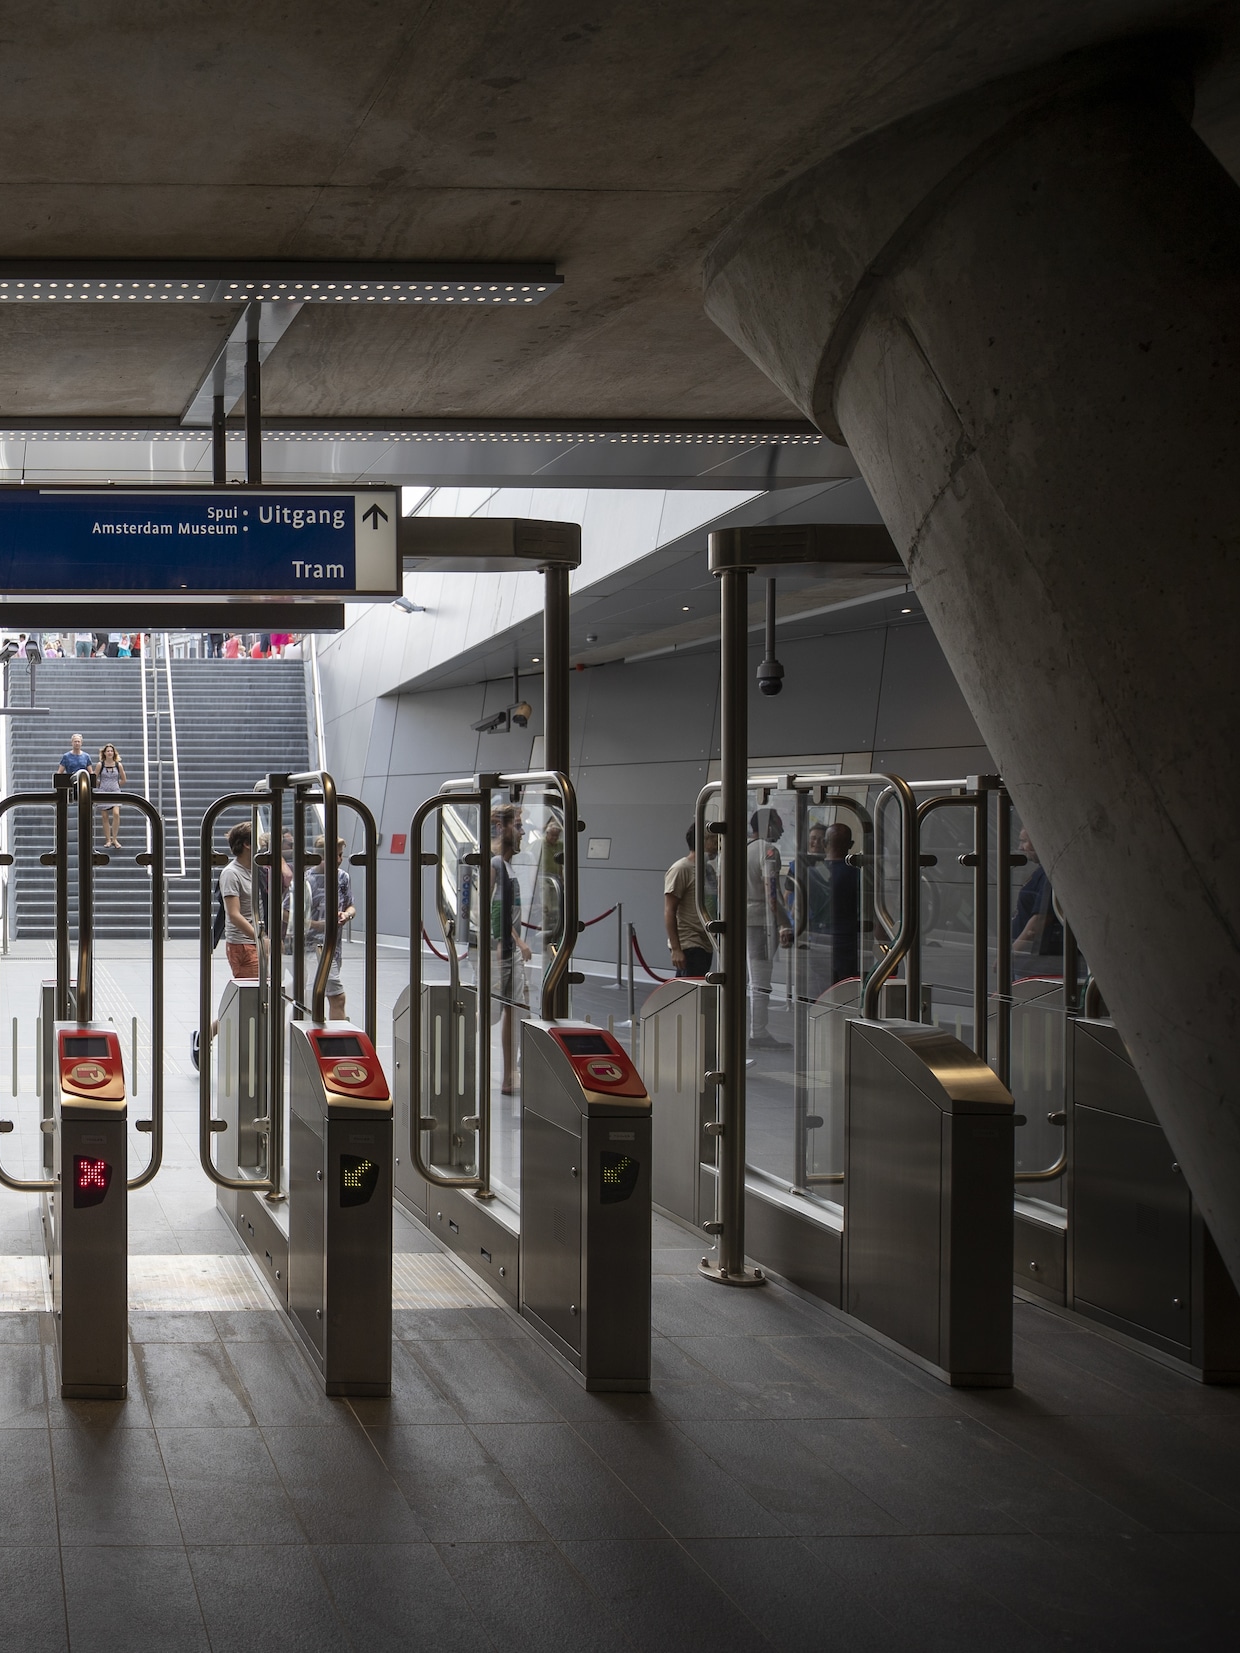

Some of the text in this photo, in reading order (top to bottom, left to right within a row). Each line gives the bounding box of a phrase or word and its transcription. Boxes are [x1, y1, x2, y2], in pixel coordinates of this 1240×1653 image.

[207, 507, 238, 521] Spui
[259, 505, 346, 529] Uitgang
[92, 522, 238, 535] Amsterdam Museum
[291, 561, 345, 579] Tram
